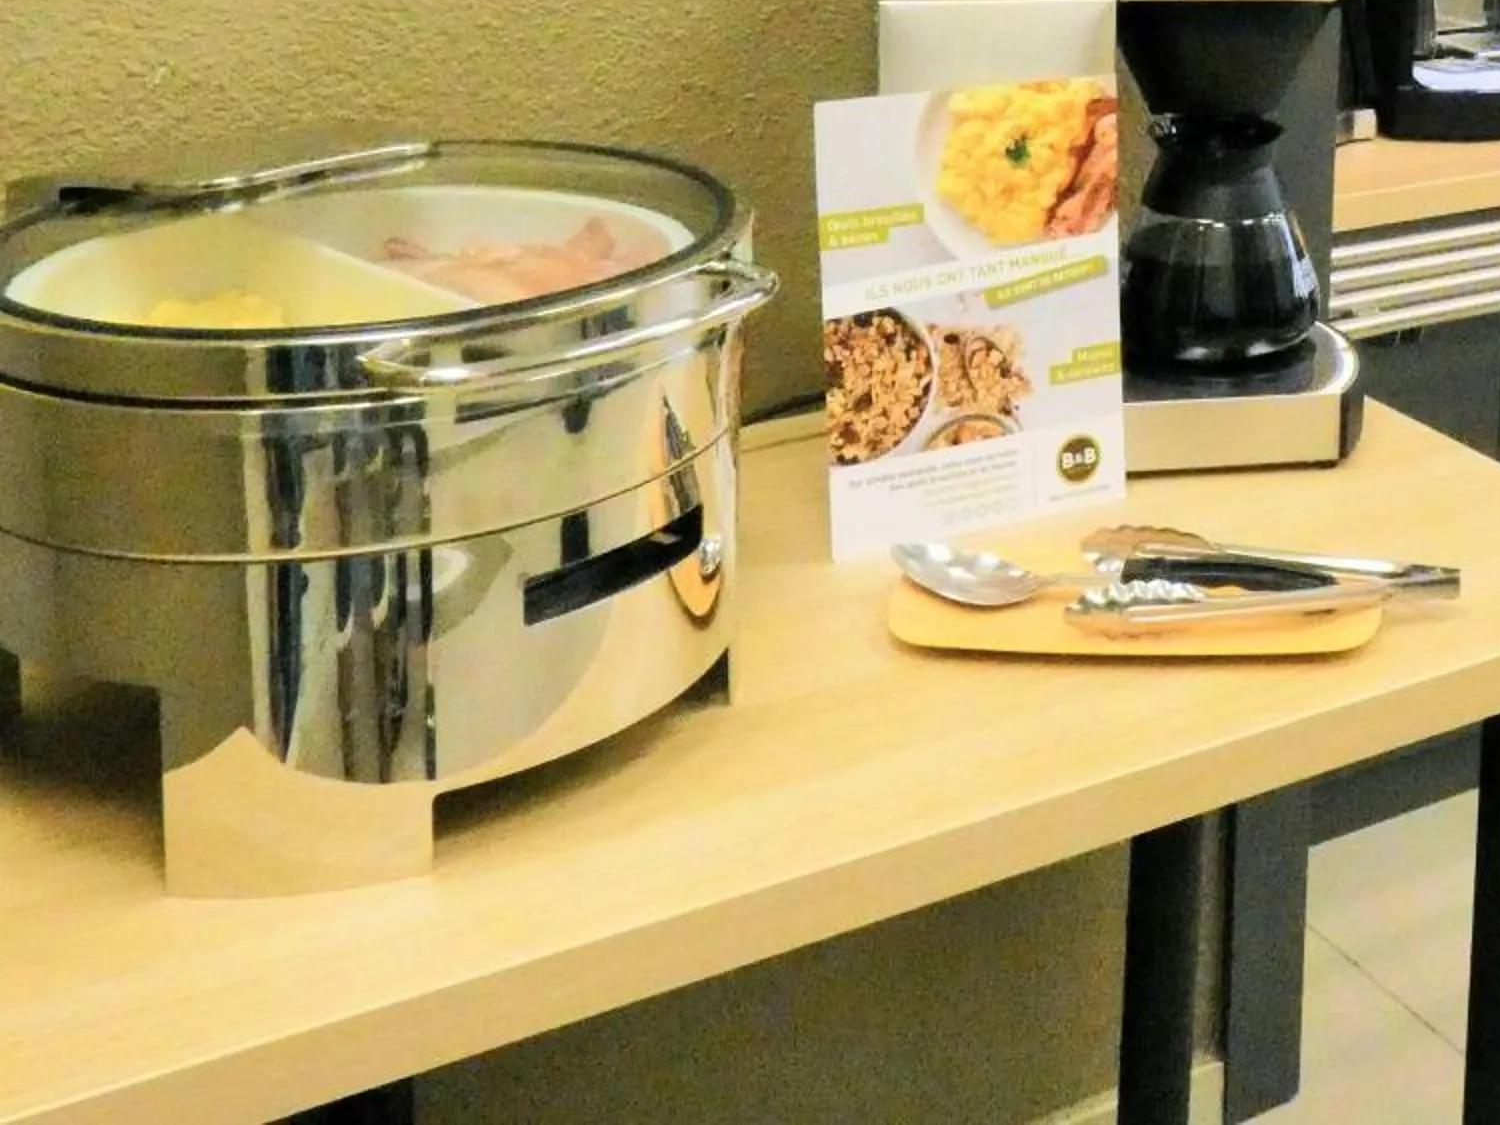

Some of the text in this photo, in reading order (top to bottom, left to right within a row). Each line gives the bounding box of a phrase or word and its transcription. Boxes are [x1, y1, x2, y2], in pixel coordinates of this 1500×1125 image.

[892, 278, 932, 297] NOUS
[968, 260, 1007, 281] TANT
[1061, 447, 1097, 470] B&B
